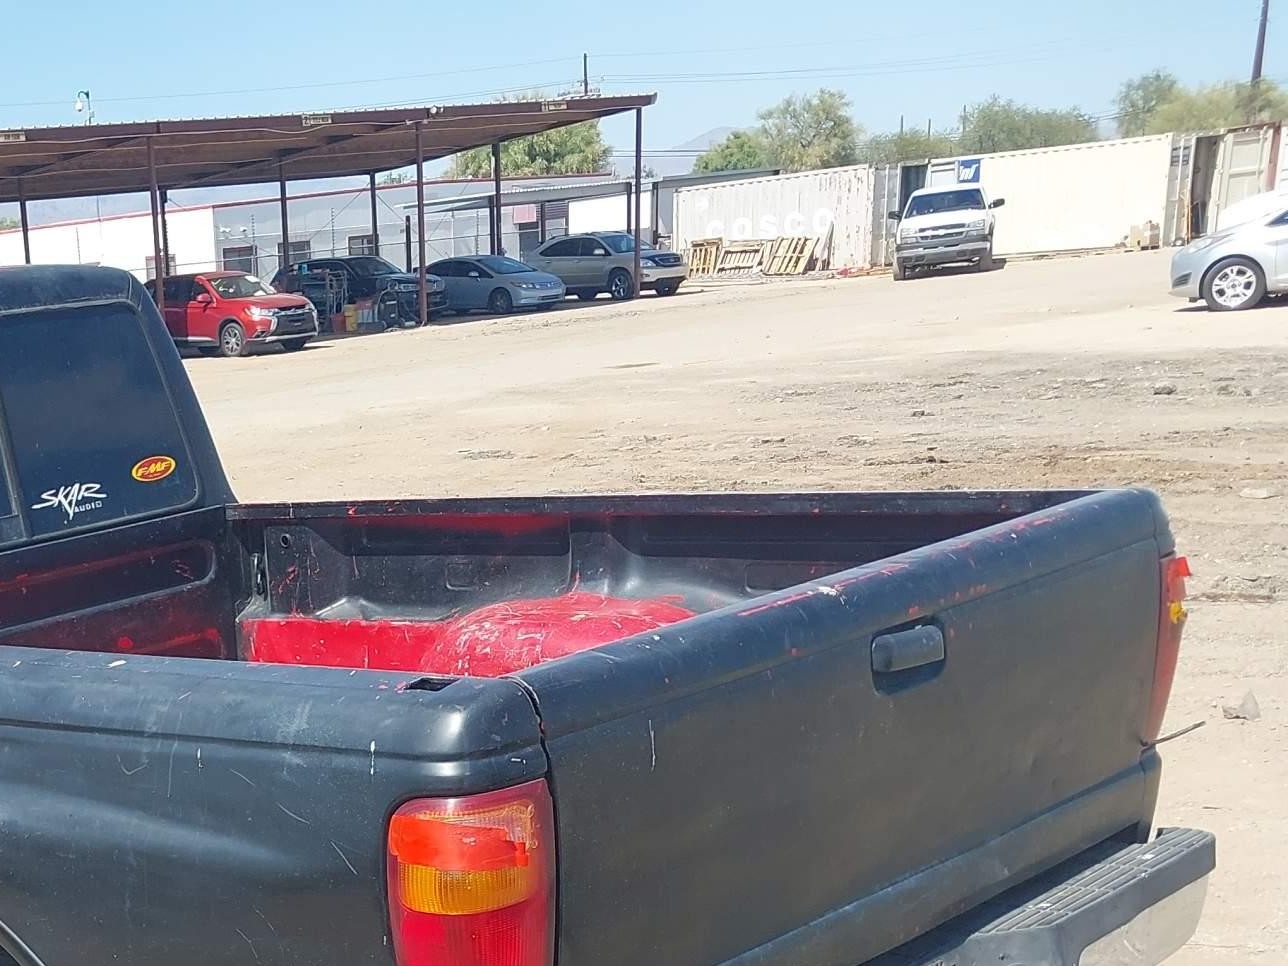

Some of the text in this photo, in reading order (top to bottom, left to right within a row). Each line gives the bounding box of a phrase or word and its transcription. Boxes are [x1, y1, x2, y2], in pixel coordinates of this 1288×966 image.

[136, 461, 171, 477] FMF
[31, 483, 107, 520] SKAR
[74, 500, 103, 512] AUDIO
